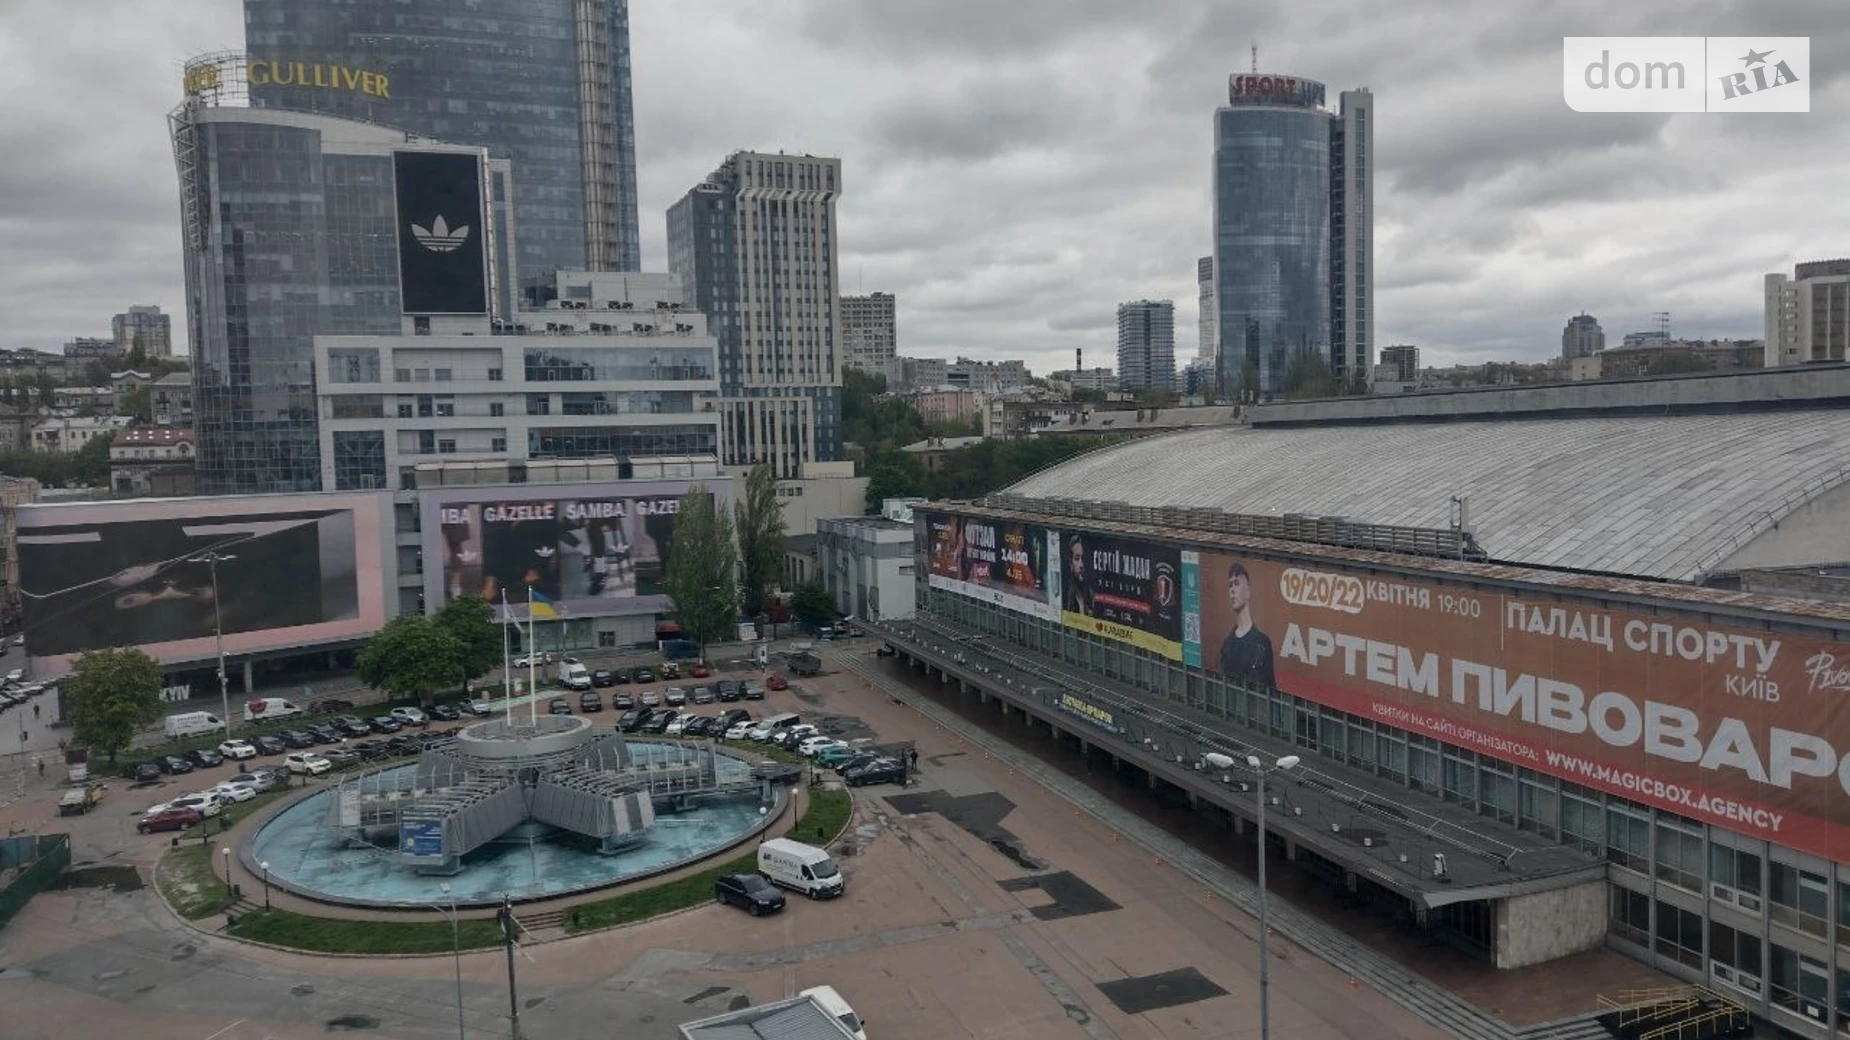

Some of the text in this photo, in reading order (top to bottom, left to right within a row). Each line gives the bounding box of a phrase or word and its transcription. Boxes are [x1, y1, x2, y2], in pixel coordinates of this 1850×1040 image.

[248, 60, 390, 99] GULLIVER
[1234, 75, 1297, 96] SPORT
[484, 503, 555, 522] GAZELLE
[566, 502, 625, 519] SAMBA
[1001, 547, 1028, 566] 14:00
[1283, 571, 1481, 618] 19/20/22 КВІТНЯ 19:00
[1506, 601, 1782, 673] ПАЛАЦ СПОРТУ
[1725, 673, 1781, 702] КИЇВ
[1279, 622, 1850, 797] АРТЕМ ПИВОВАР
[1372, 702, 1410, 721] КВИТКИ
[1410, 714, 1425, 727] НА
[1459, 727, 1540, 762] ОРГАНІЗАТОРА:
[1545, 749, 1784, 833] WWW.MAGICBOX.AGENCY
